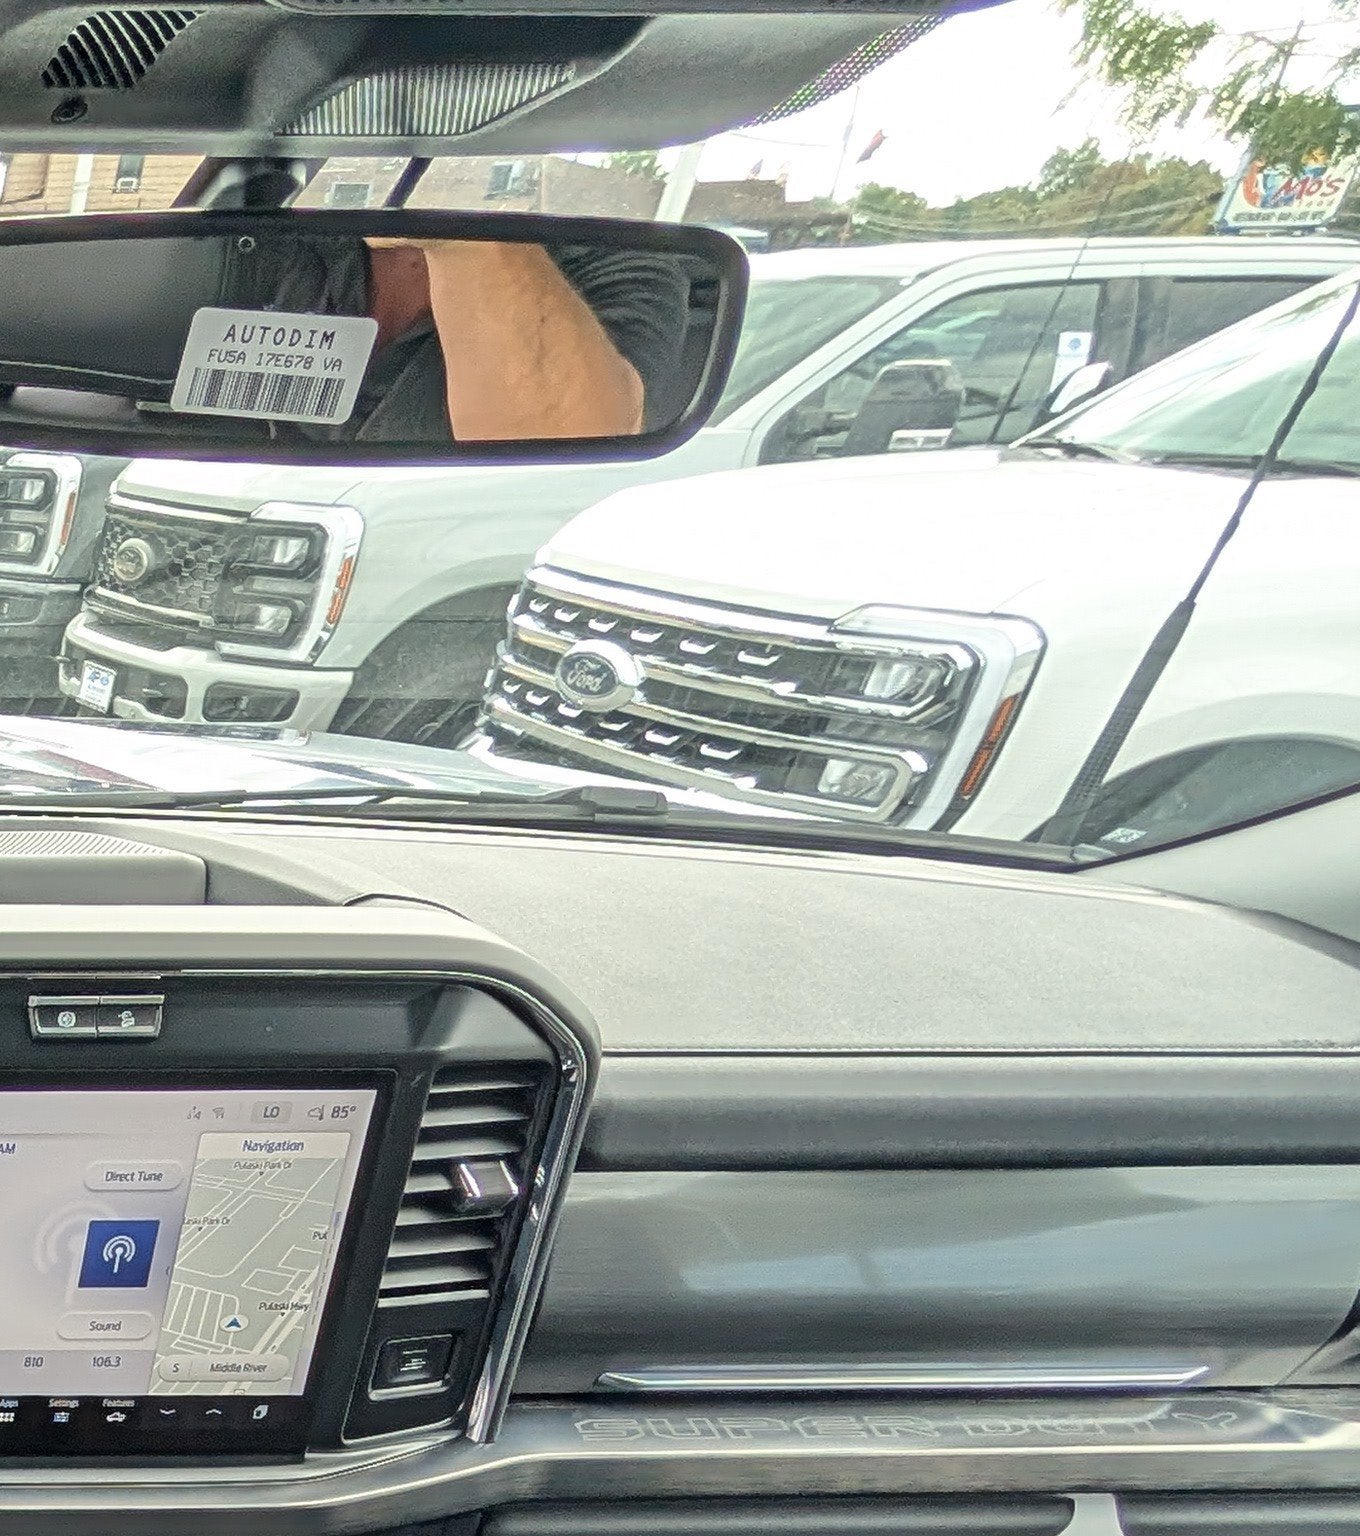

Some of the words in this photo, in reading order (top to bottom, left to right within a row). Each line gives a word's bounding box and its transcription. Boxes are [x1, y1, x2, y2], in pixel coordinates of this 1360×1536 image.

[223, 324, 336, 350] AUTODIM
[568, 659, 608, 692] Ford
[331, 1105, 357, 1119] 85°
[242, 1139, 304, 1152] Navigation
[105, 1171, 135, 1183] Direct
[137, 1171, 164, 1183] Tune
[89, 1320, 122, 1332] Sound
[23, 1357, 44, 1368] 810
[92, 1357, 121, 1368] 106.3
[573, 1414, 940, 1442] SUPER
